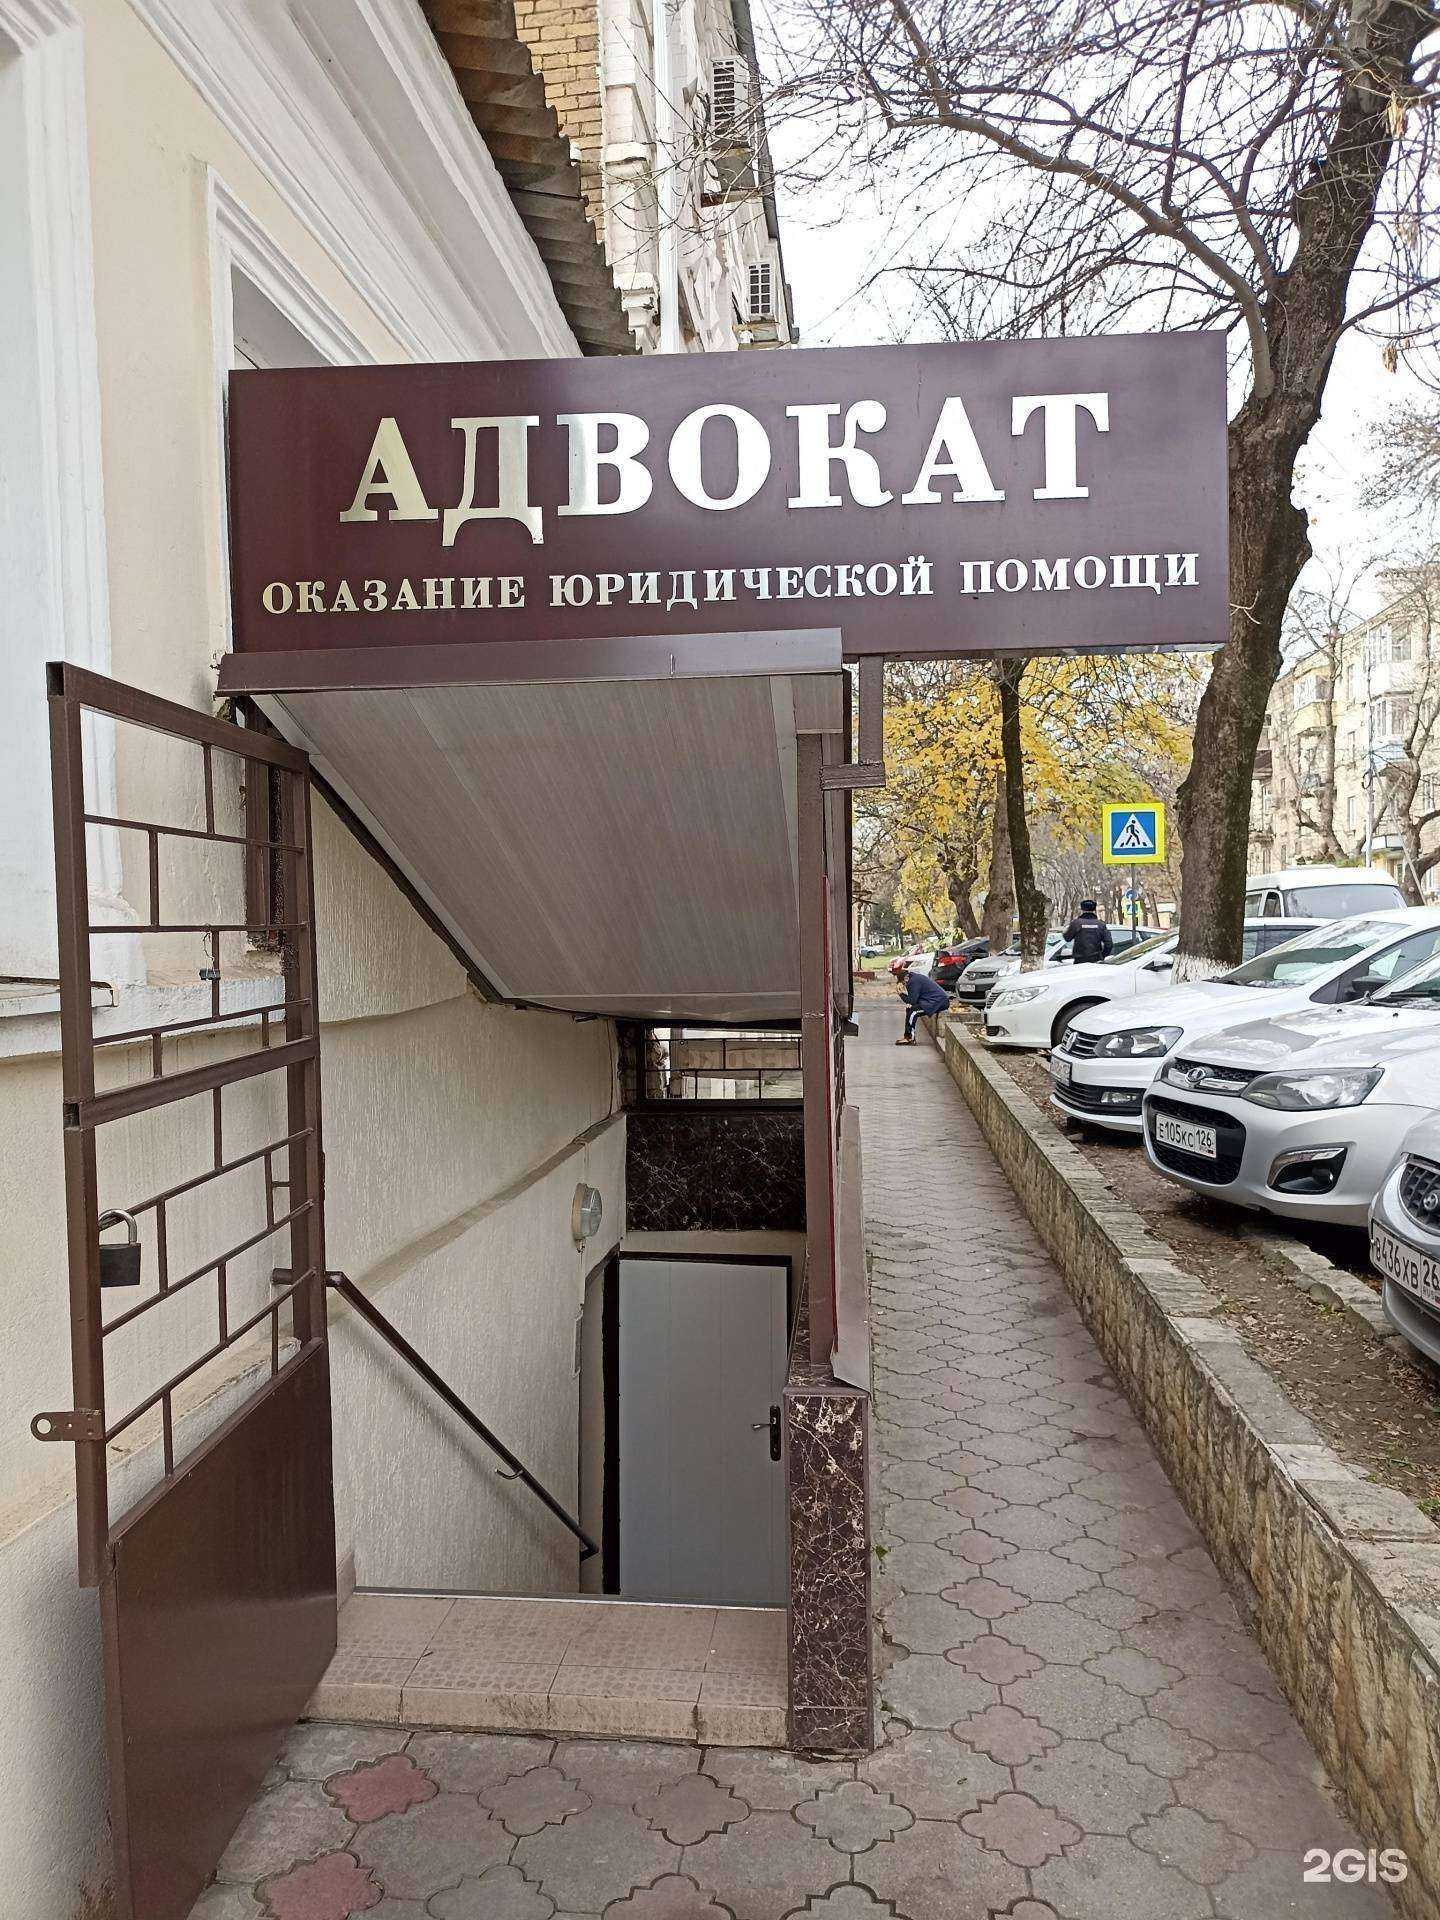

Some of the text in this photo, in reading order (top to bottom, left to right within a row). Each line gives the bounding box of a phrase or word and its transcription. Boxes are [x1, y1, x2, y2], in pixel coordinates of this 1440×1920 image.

[339, 394, 1109, 547] АДВОКАТ
[262, 553, 1200, 614] ОКАЗАНИЕ ЮРИДИЧЕСКОЙ ПОМОЩИ
